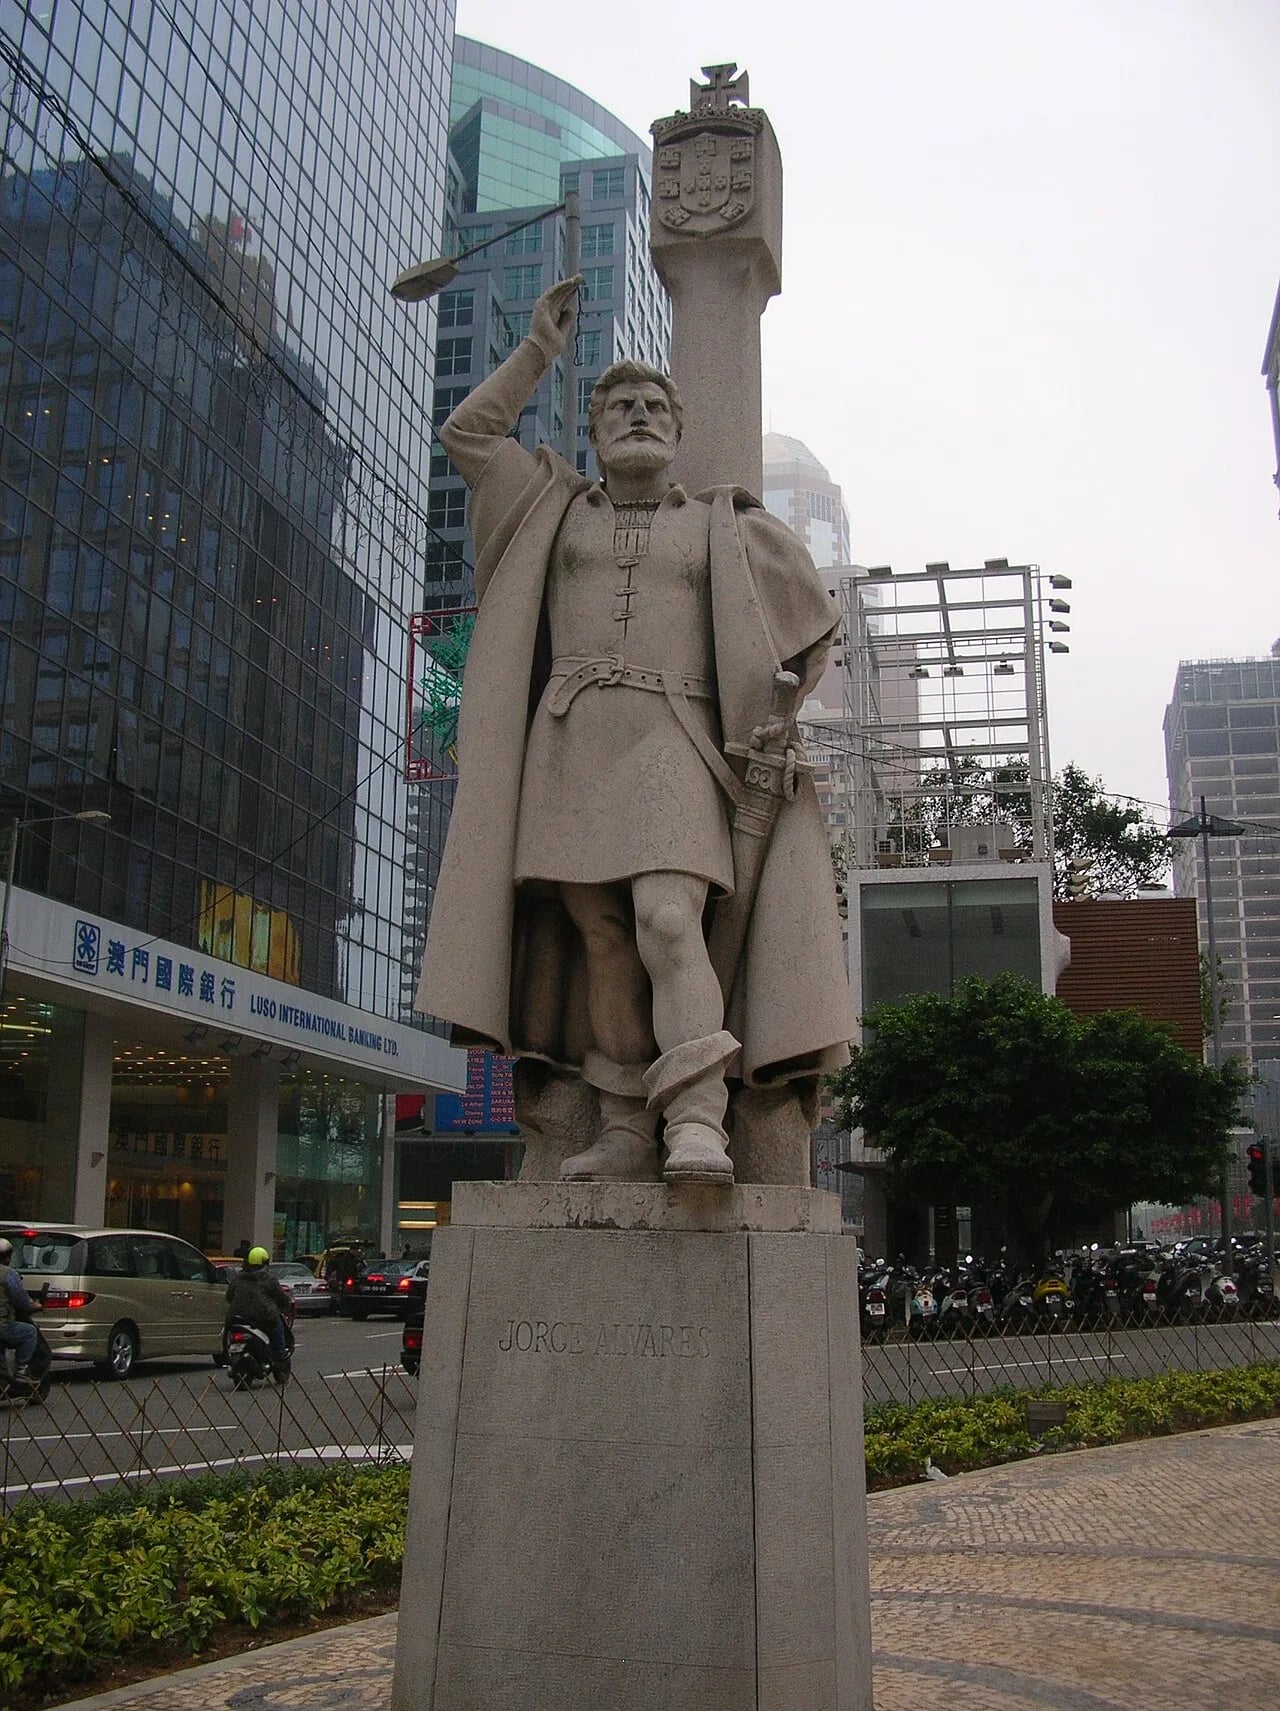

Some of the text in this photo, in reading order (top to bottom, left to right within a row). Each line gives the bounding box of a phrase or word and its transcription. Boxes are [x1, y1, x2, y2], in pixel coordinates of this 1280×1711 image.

[106, 939, 236, 1010] 澳門國際銀行
[250, 994, 399, 1057] LUSO INTERNATIONAL BANKING LTD.
[498, 1320, 584, 1354] JORGE
